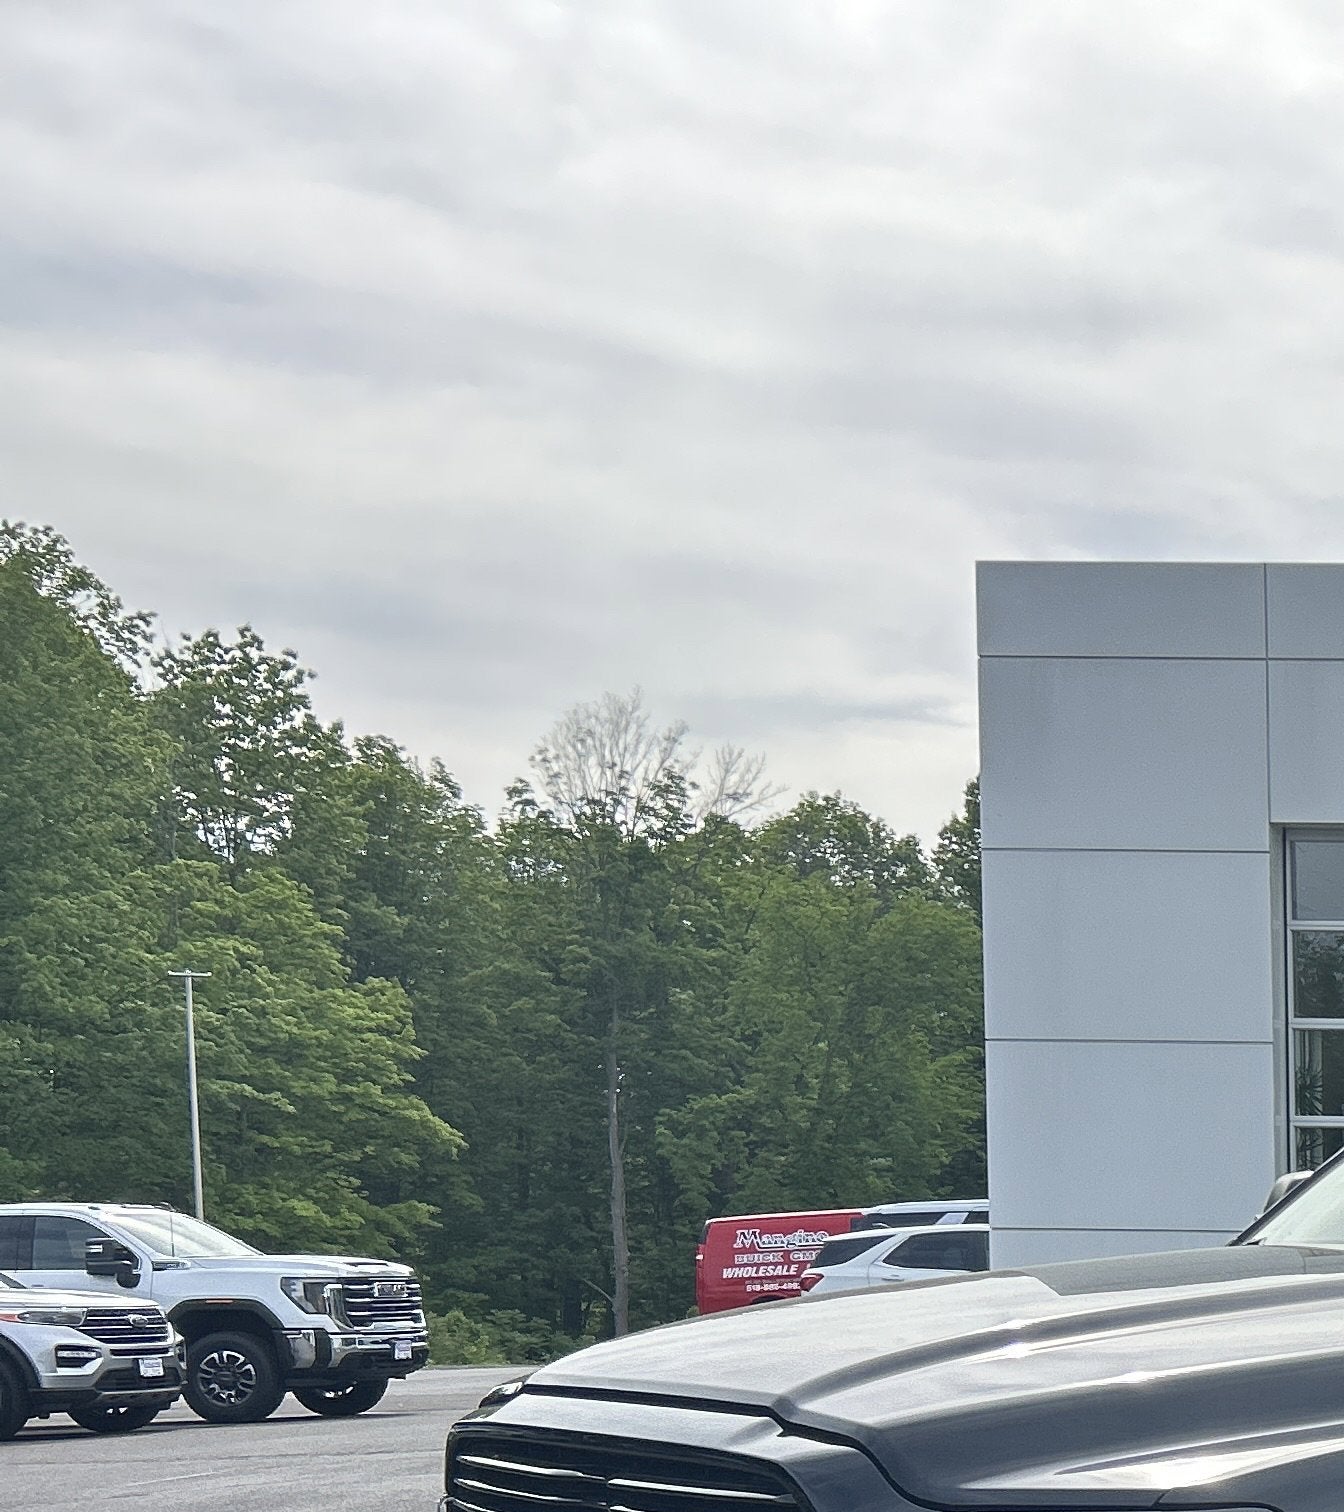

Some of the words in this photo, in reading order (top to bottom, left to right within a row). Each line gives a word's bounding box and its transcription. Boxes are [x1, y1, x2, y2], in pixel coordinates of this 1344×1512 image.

[733, 1229, 829, 1251] Mangino
[735, 1252, 784, 1264] BUICK
[722, 1264, 799, 1278] WHOLESALE
